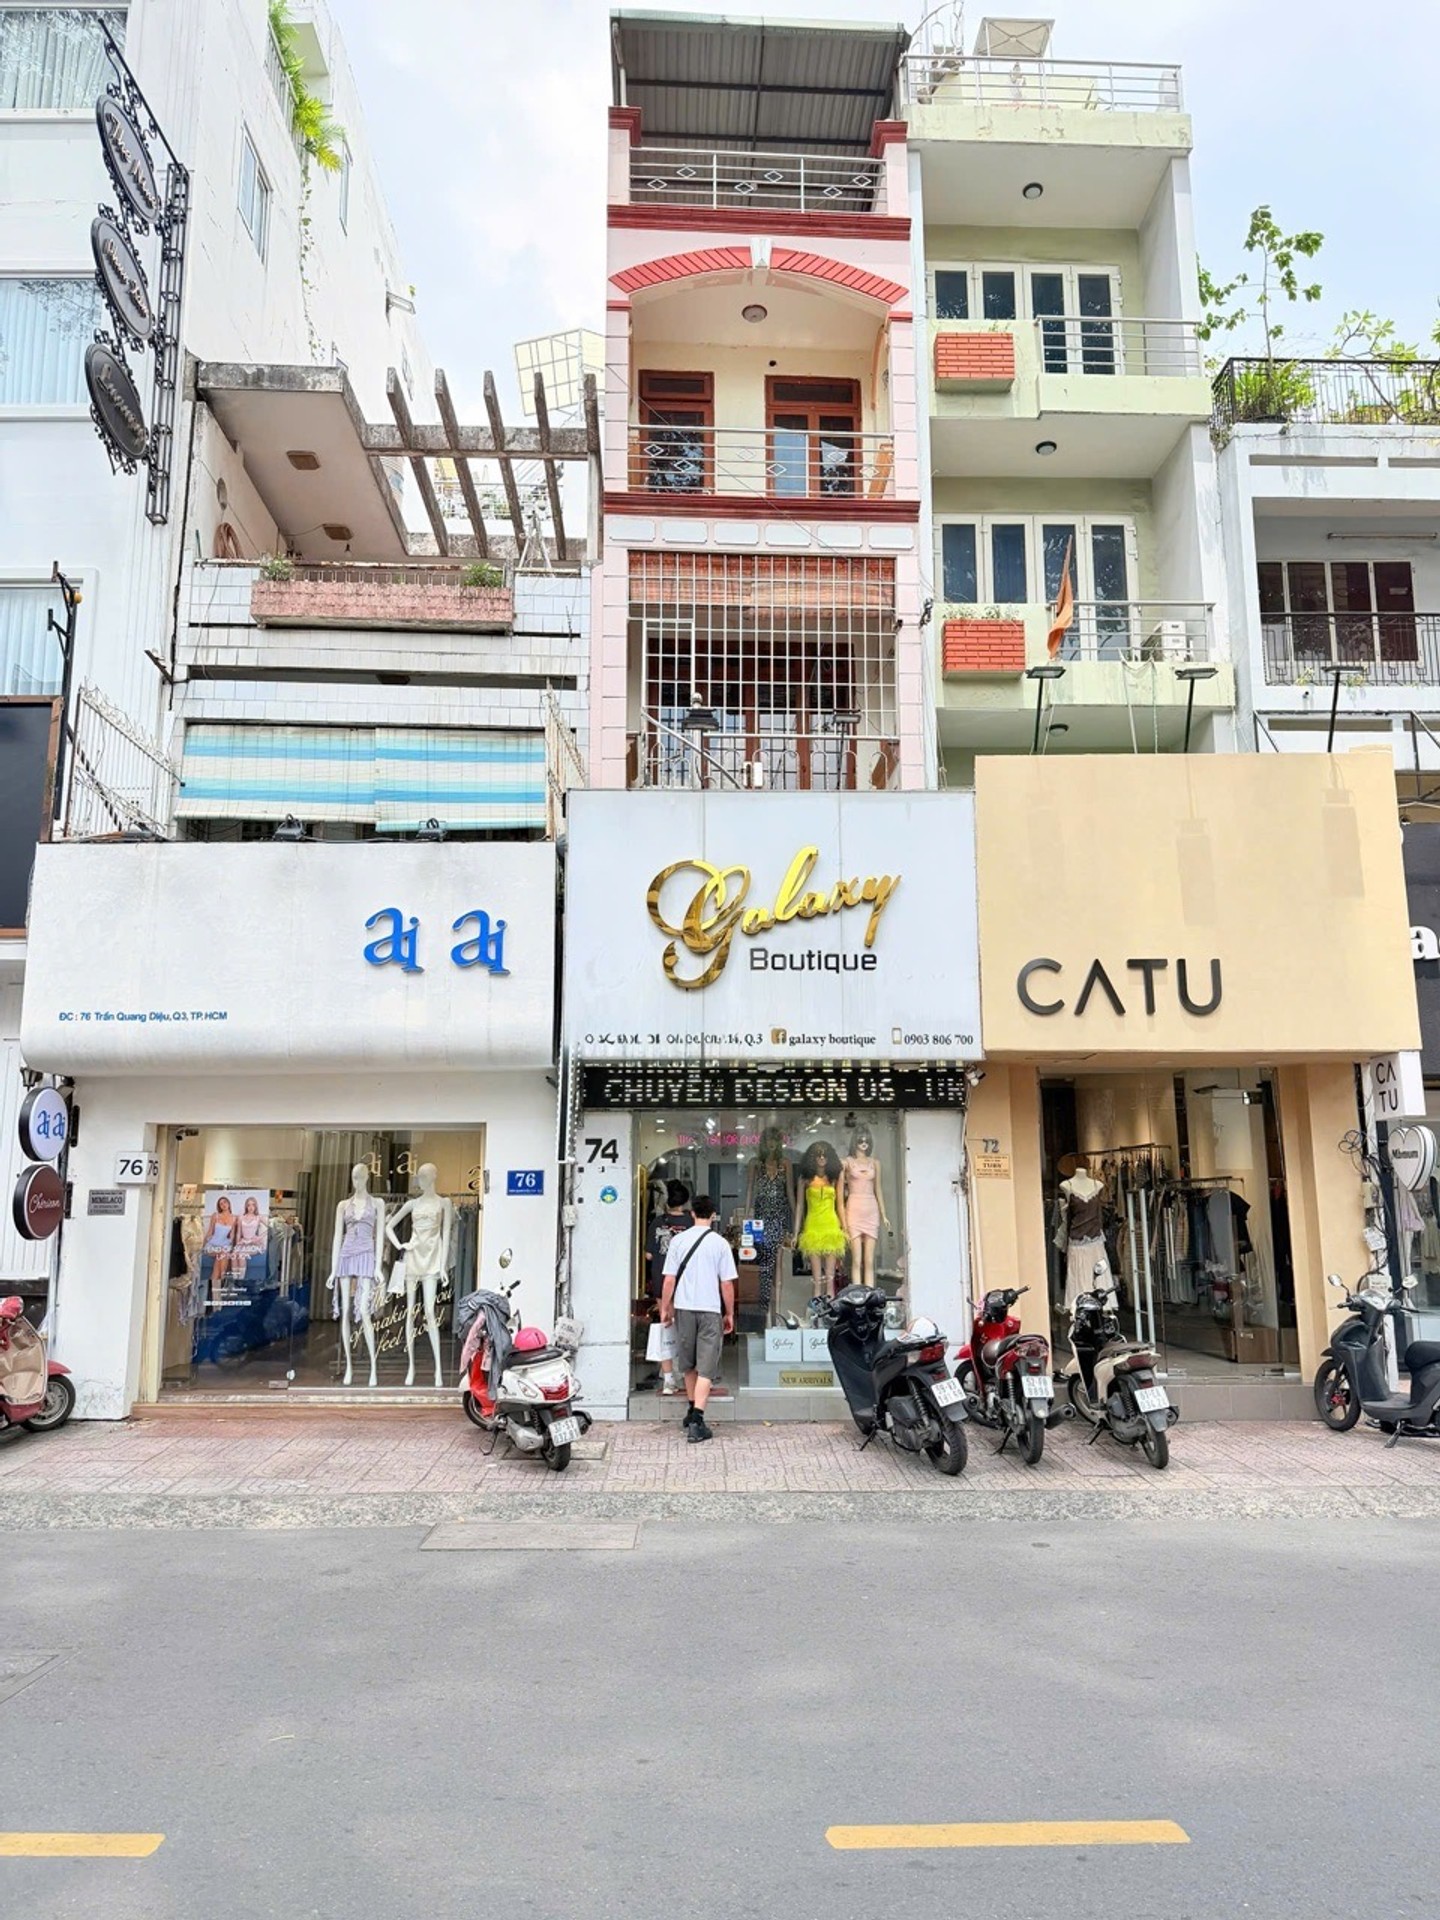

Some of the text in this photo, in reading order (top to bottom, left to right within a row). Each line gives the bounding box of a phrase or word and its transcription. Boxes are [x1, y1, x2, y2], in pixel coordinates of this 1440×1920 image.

[646, 845, 901, 989] Galaxy
[750, 948, 877, 974] Boutique
[1017, 958, 1222, 1017] CATU
[80, 1012, 91, 1021] 76
[116, 1012, 146, 1023] Quang
[745, 1033, 763, 1046] Q.3
[789, 1033, 827, 1046] galaxy
[829, 1033, 876, 1047] boutique
[904, 1033, 973, 1045] 0903 806 700
[1375, 1060, 1397, 1084] CA
[735, 1078, 847, 1103] DESIGN
[1379, 1088, 1398, 1113] TU
[585, 1138, 619, 1163] 74
[982, 1138, 999, 1153] 72
[119, 1159, 143, 1176] 76
[148, 1160, 159, 1176] 76
[515, 1172, 536, 1188] 76
